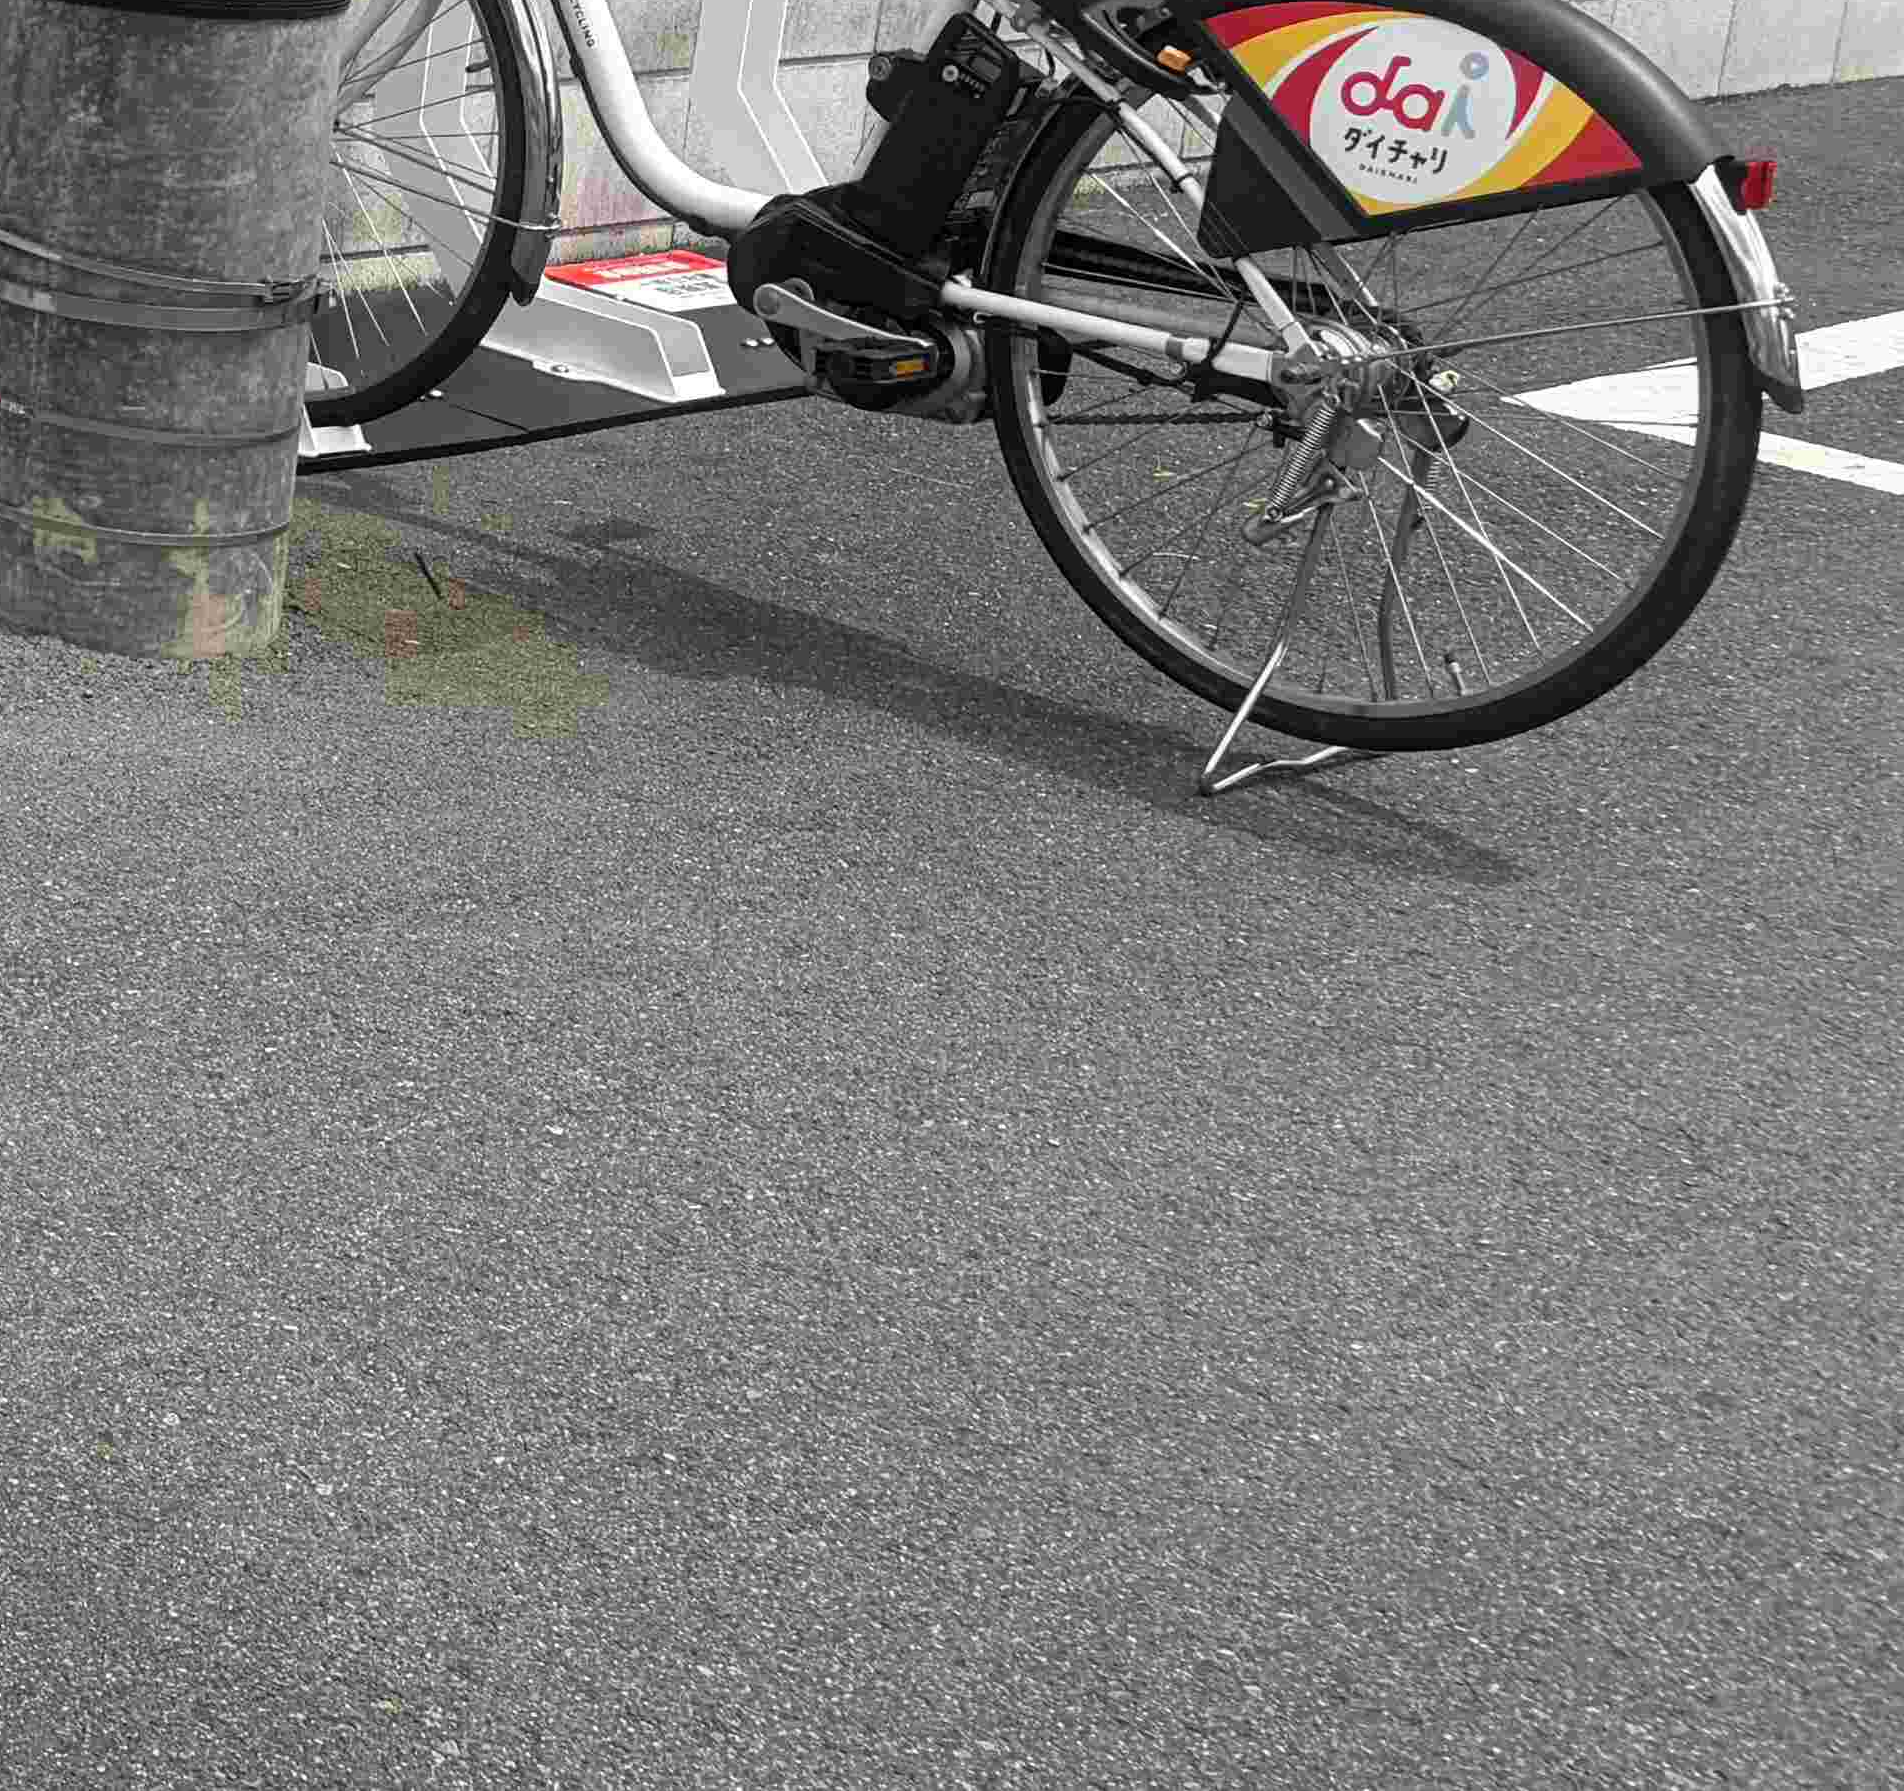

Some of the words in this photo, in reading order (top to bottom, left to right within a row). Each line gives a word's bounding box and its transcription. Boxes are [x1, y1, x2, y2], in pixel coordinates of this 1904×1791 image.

[1340, 52, 1490, 140] dai
[1343, 125, 1449, 175] ダイチャリ
